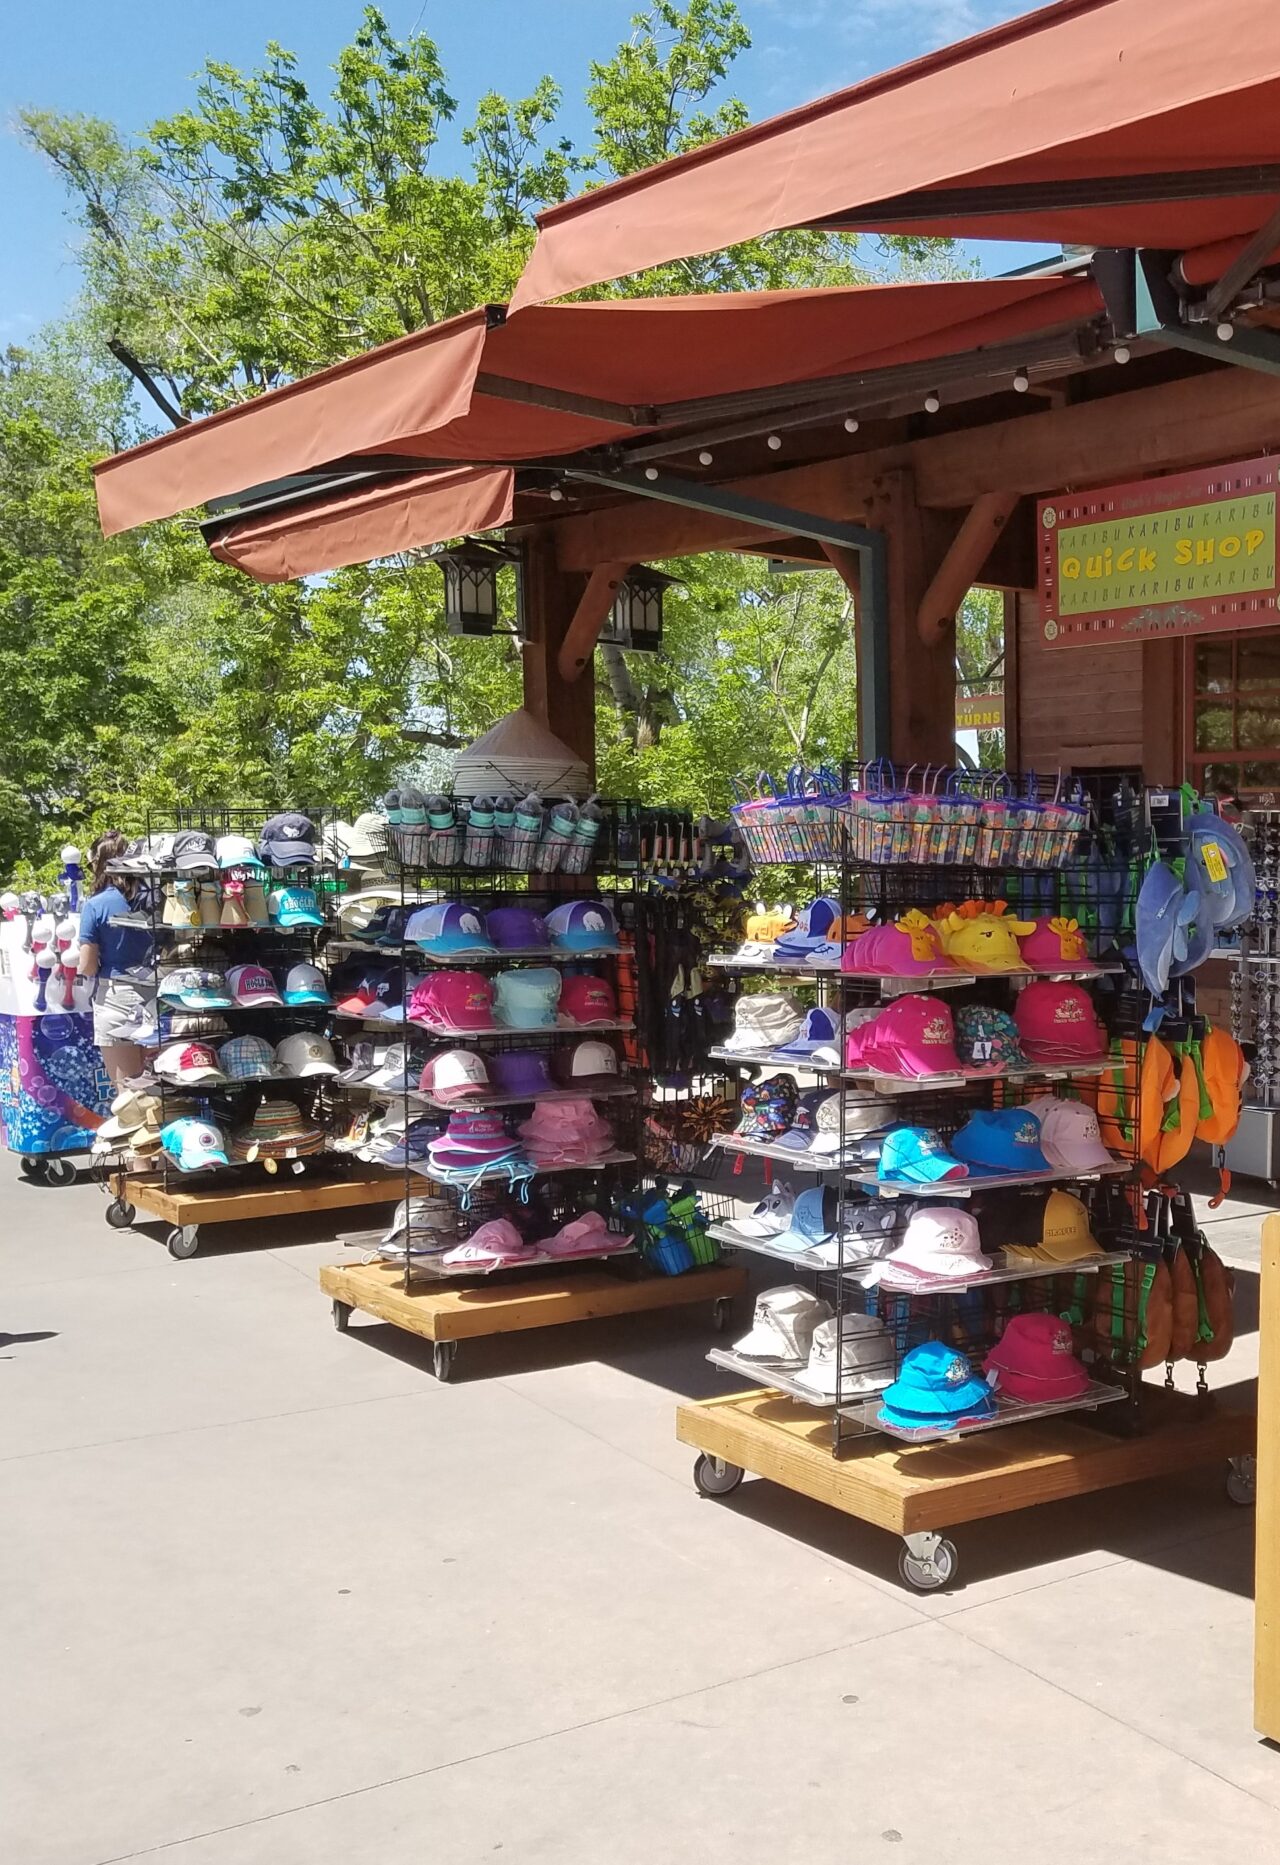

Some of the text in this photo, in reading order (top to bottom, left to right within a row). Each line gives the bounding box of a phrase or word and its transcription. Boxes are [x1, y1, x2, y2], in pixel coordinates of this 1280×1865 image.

[1059, 501, 1275, 550] KARIBU KARIBU KARIBU
[1174, 528, 1265, 566] SHOP
[1060, 564, 1274, 607] KARIBU KARIBU KARIBU
